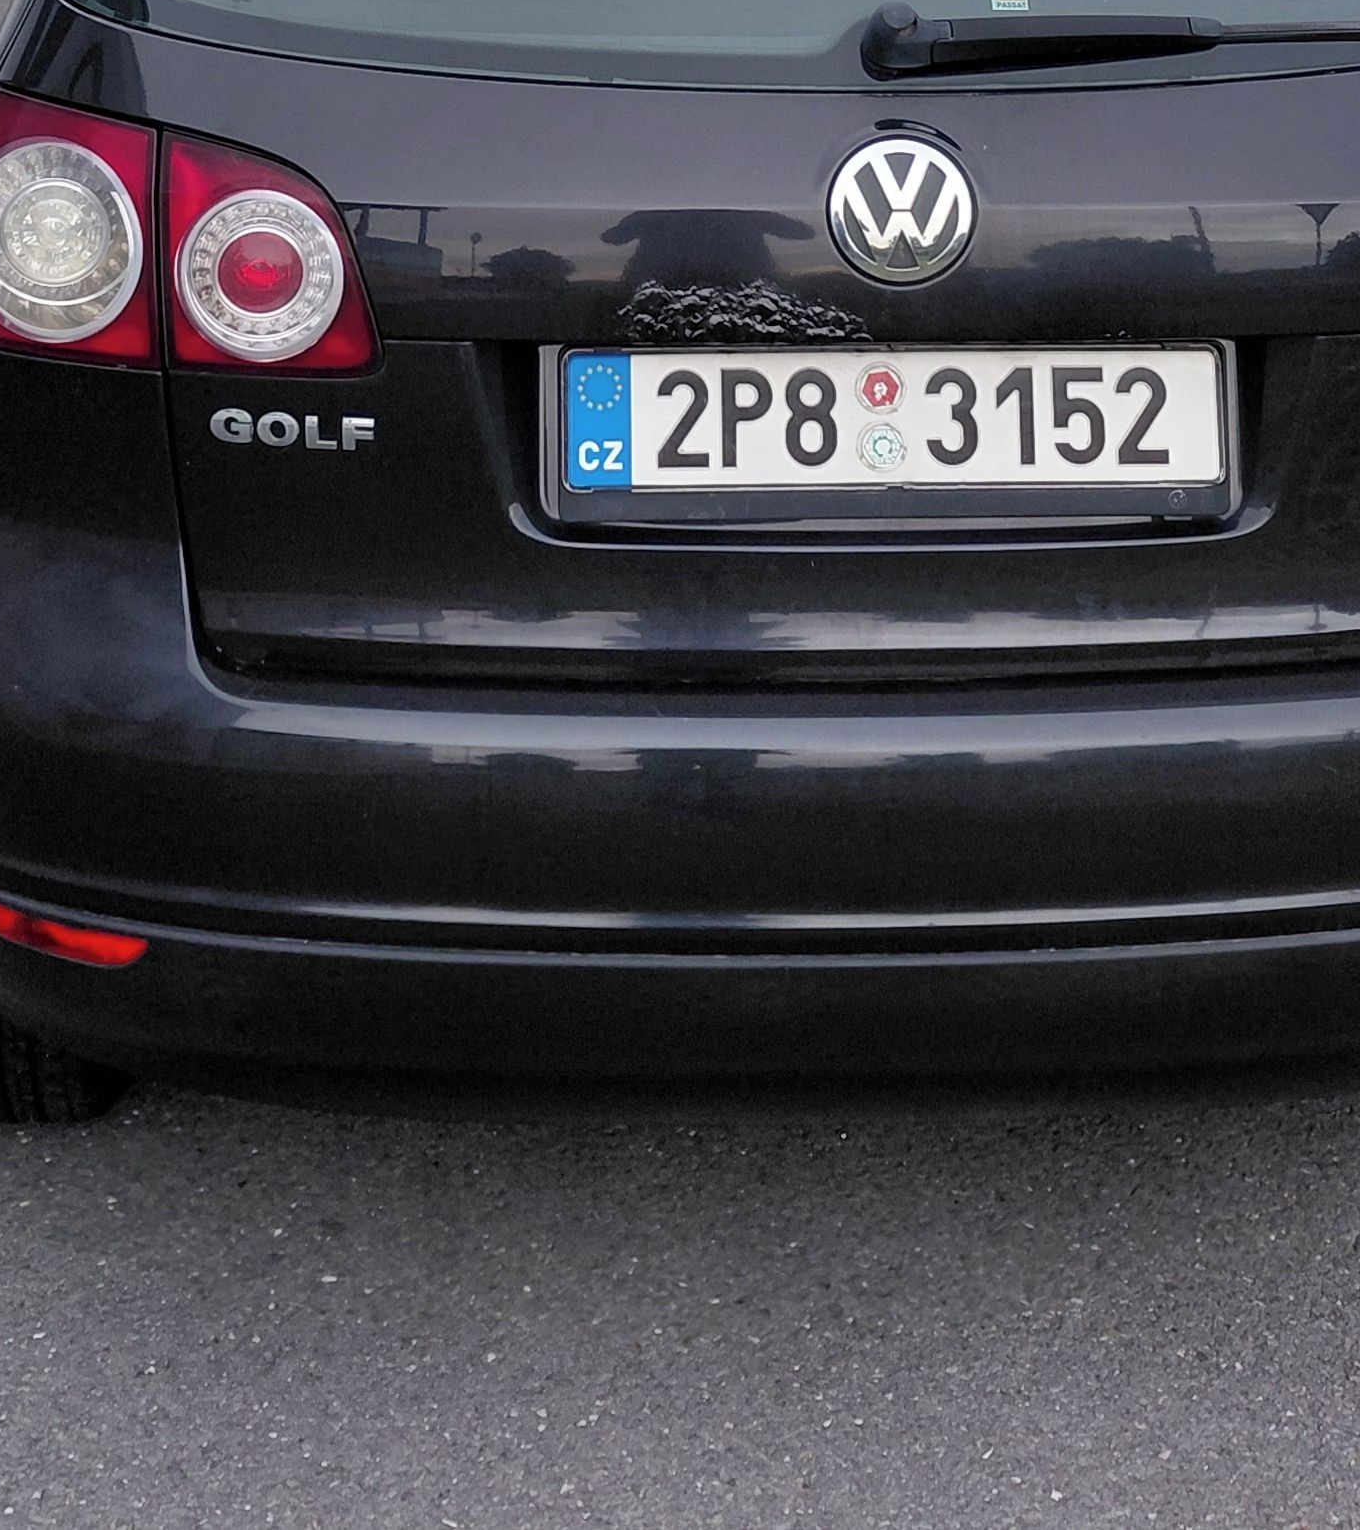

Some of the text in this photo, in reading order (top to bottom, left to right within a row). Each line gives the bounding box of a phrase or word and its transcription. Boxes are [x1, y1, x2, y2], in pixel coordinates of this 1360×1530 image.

[210, 408, 375, 451] GOLF
[655, 367, 1171, 469] 2P8 3152
[578, 441, 624, 471] CZ
